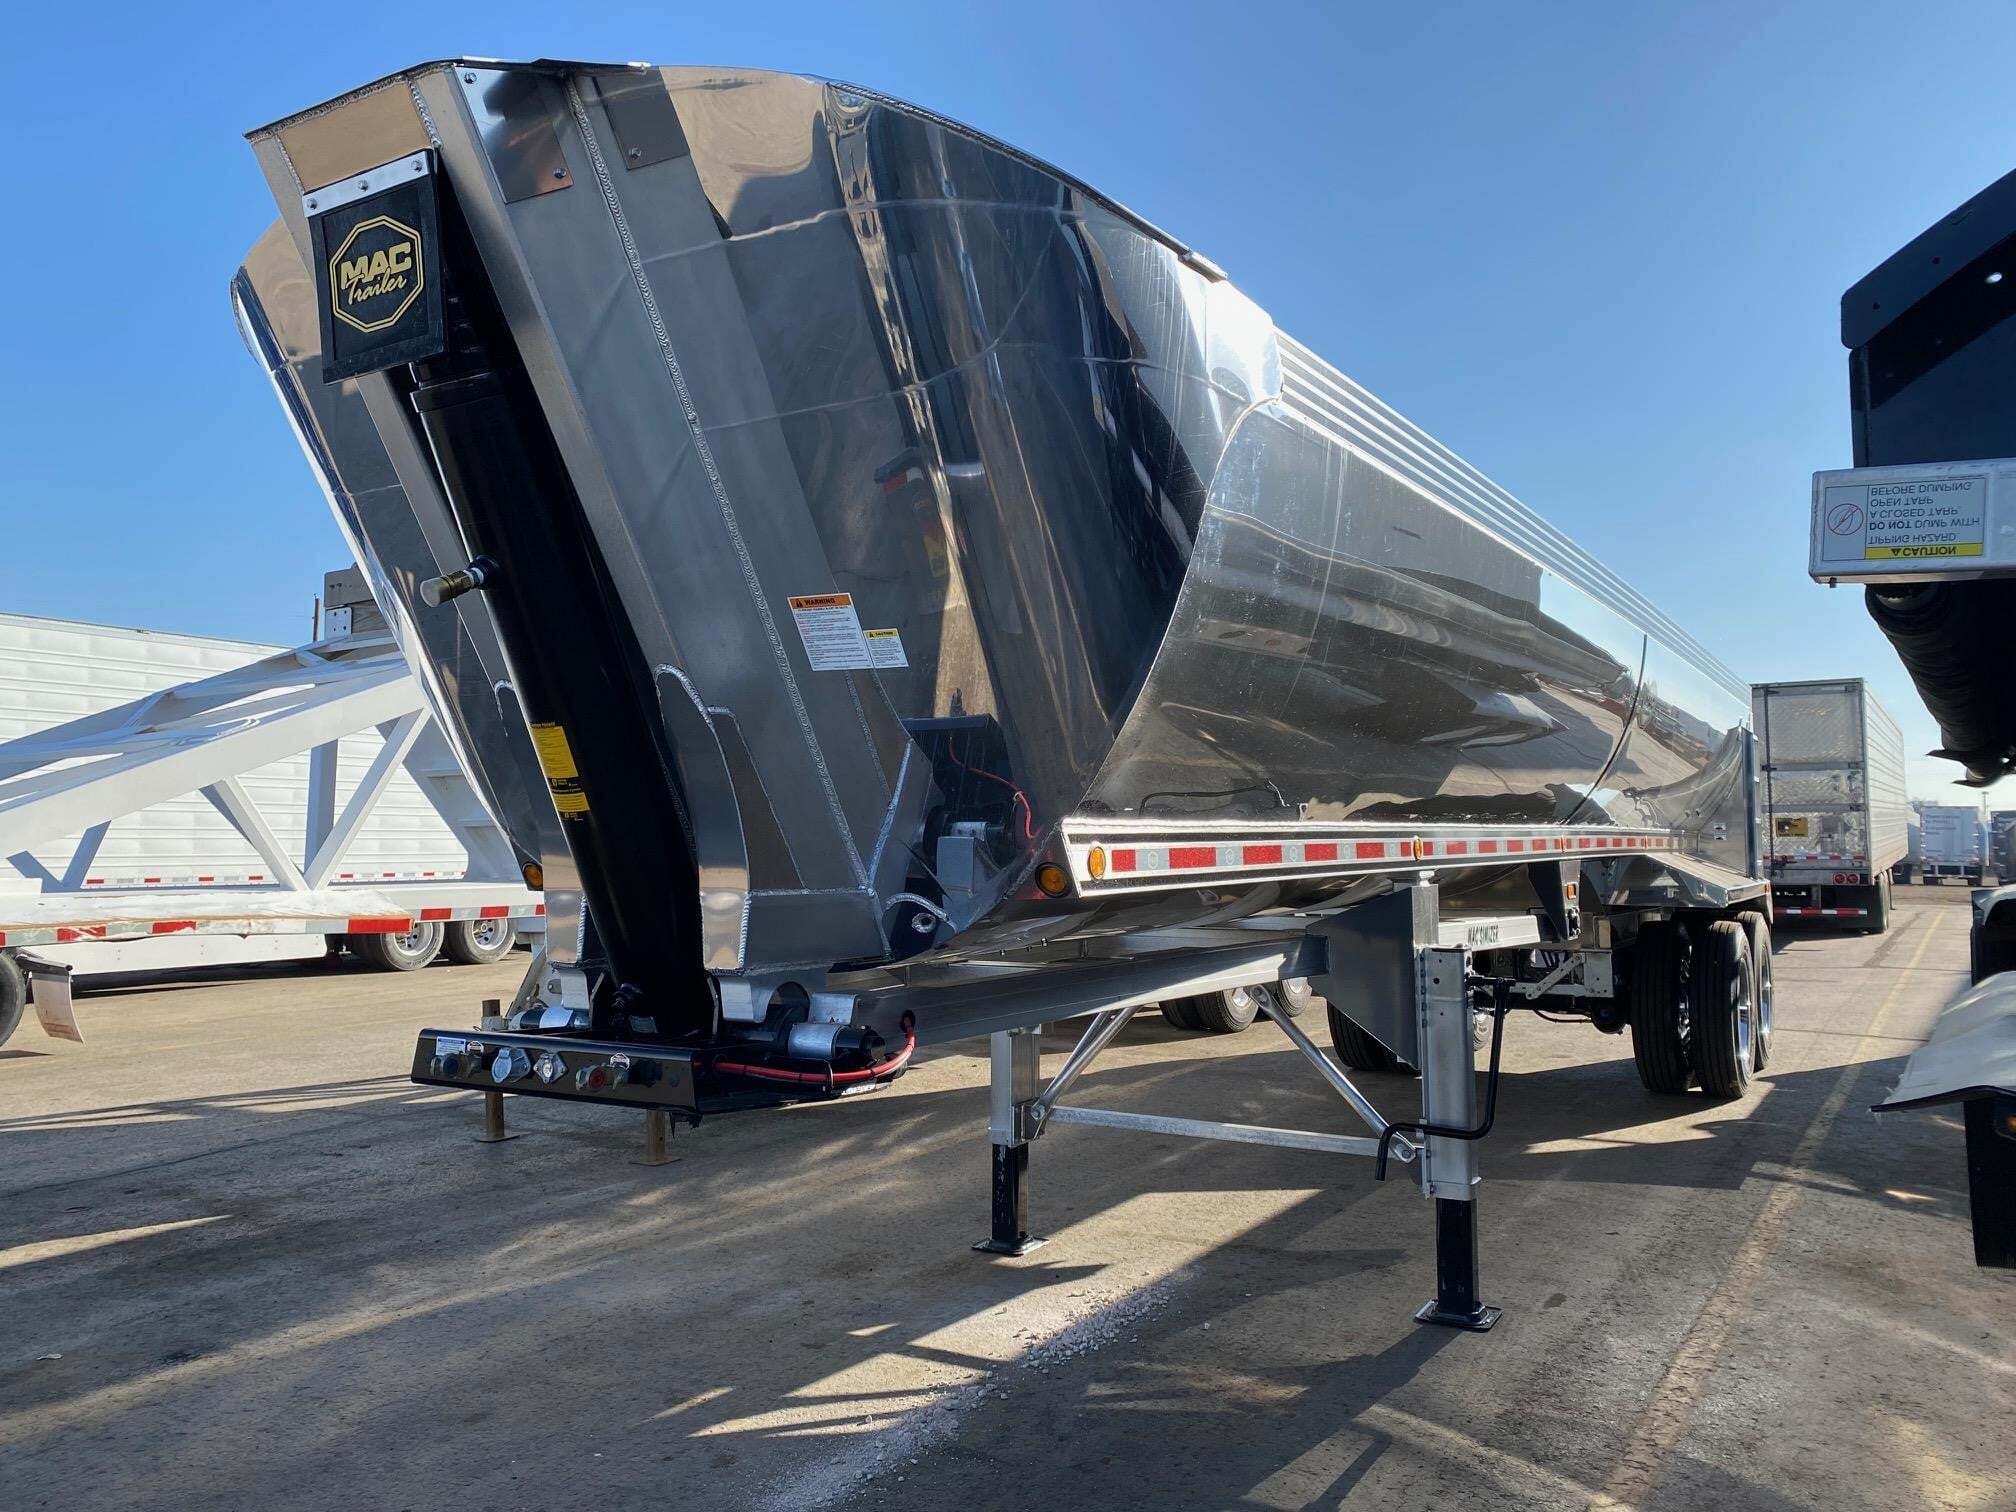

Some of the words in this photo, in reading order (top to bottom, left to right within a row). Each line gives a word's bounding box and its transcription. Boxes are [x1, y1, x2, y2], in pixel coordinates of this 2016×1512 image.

[341, 242, 412, 290] MAC
[345, 266, 407, 305] Trailer
[804, 597, 836, 606] WARNING
